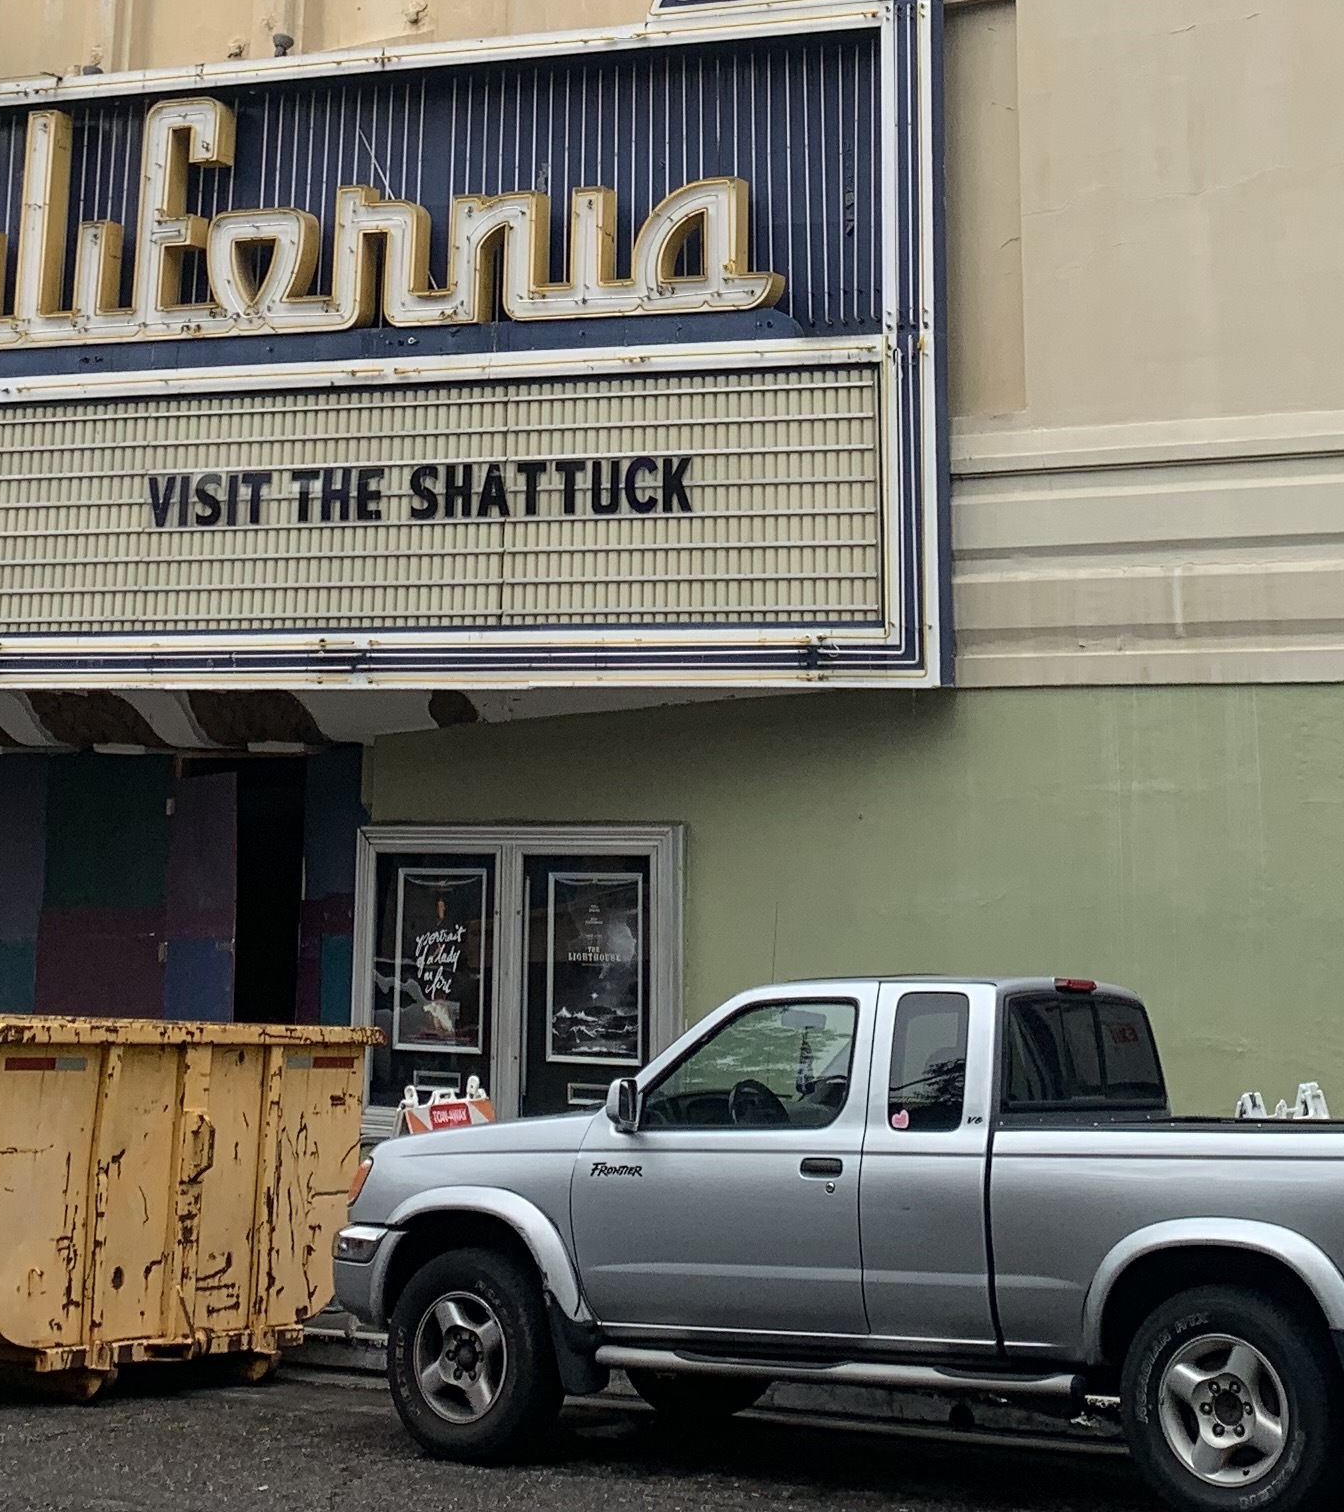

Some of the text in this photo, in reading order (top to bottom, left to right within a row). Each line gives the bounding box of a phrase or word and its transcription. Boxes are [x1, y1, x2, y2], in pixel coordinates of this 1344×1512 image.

[148, 457, 693, 528] VISIT THE SHATTUCK
[416, 924, 466, 956] portrait
[433, 944, 461, 972] lady
